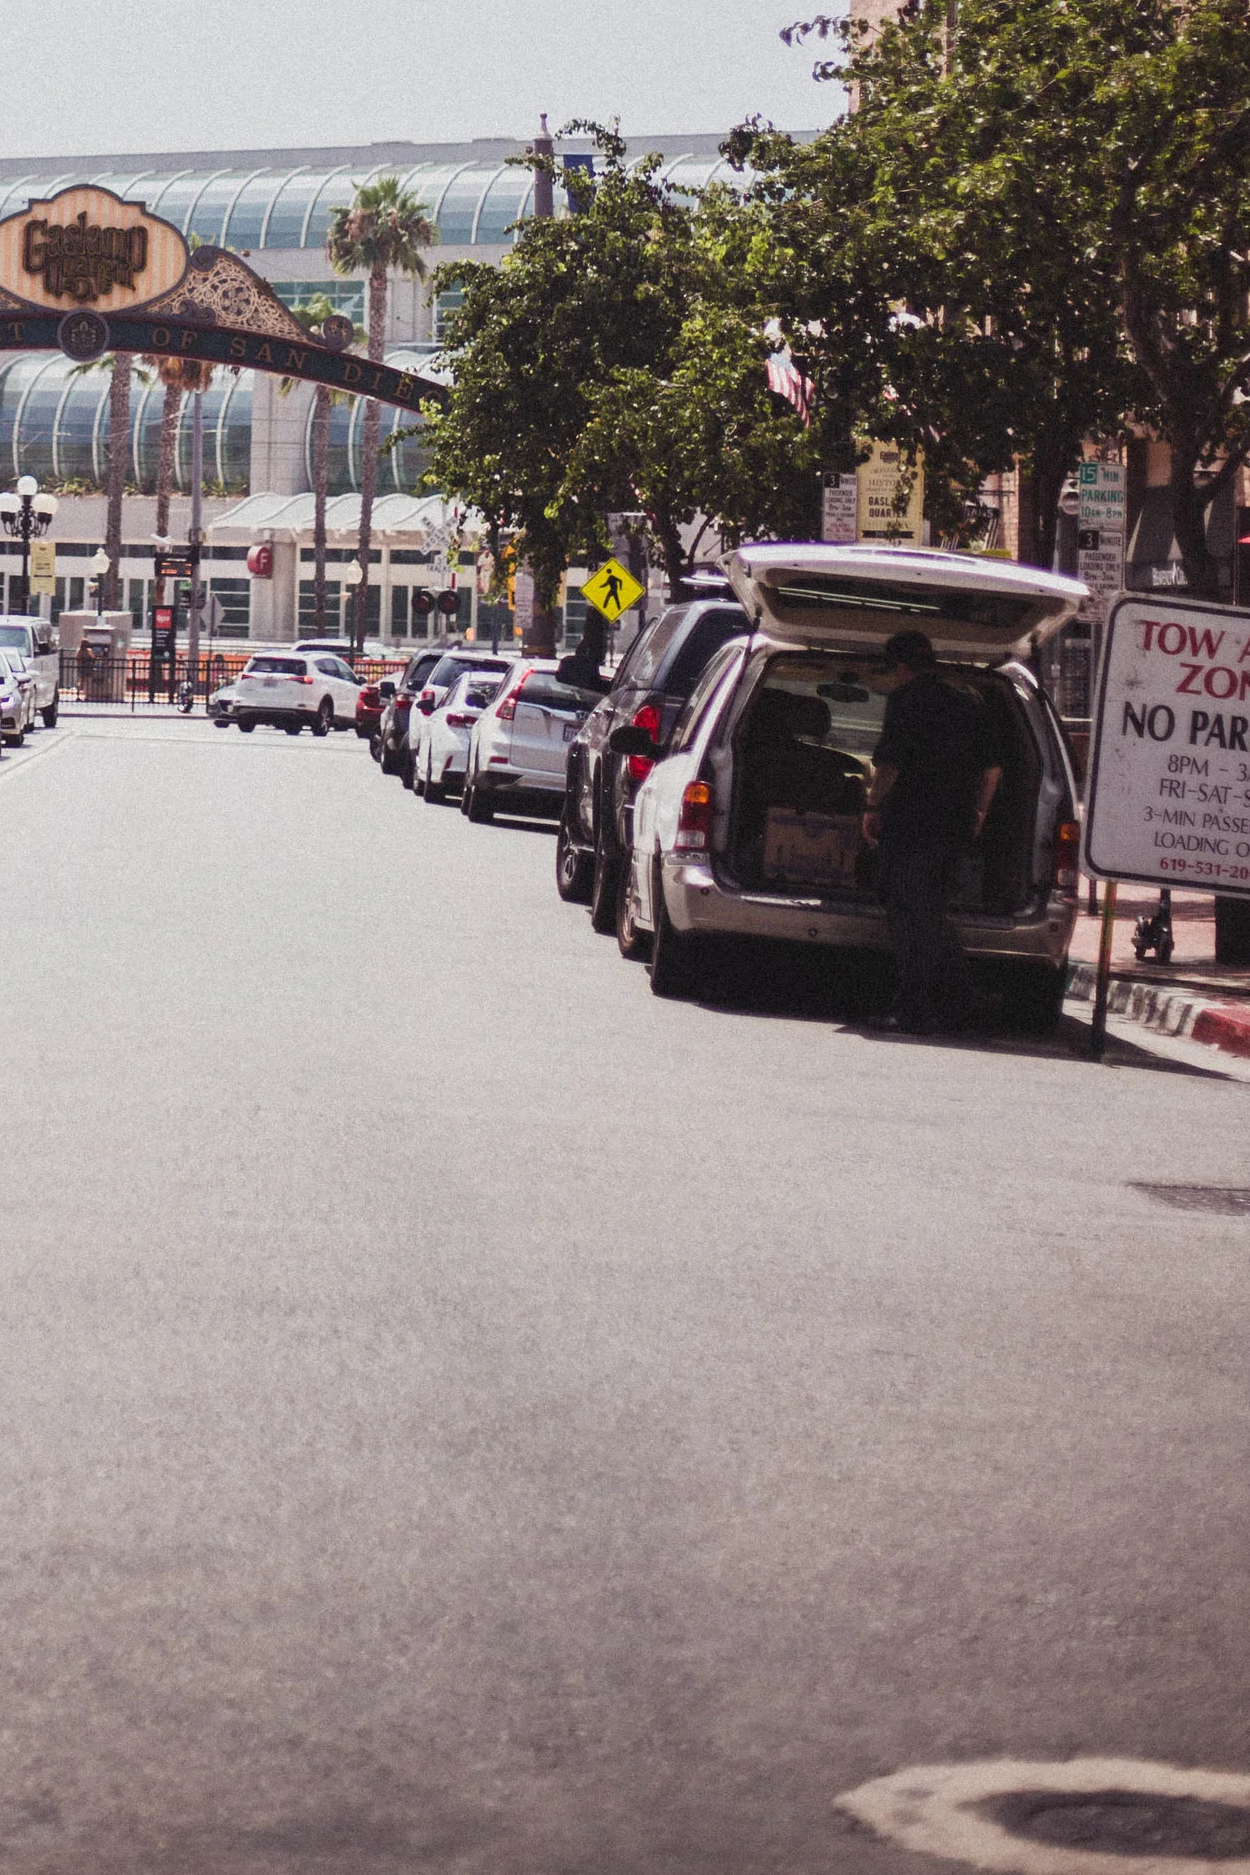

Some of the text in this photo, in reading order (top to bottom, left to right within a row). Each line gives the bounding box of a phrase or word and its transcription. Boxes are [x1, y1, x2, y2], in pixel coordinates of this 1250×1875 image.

[23, 211, 149, 274] Gaslamp
[152, 326, 198, 350] OF
[229, 337, 309, 370] SAN
[1081, 465, 1119, 482] 15 MIN
[1081, 488, 1124, 503] PARKING
[1086, 532, 1093, 547] 3
[1139, 619, 1226, 660] TOW
[1122, 701, 1176, 742] NO
[1167, 754, 1209, 778] 8PM
[1143, 806, 1196, 827] 3-MIN
[1154, 831, 1230, 856] LOADING
